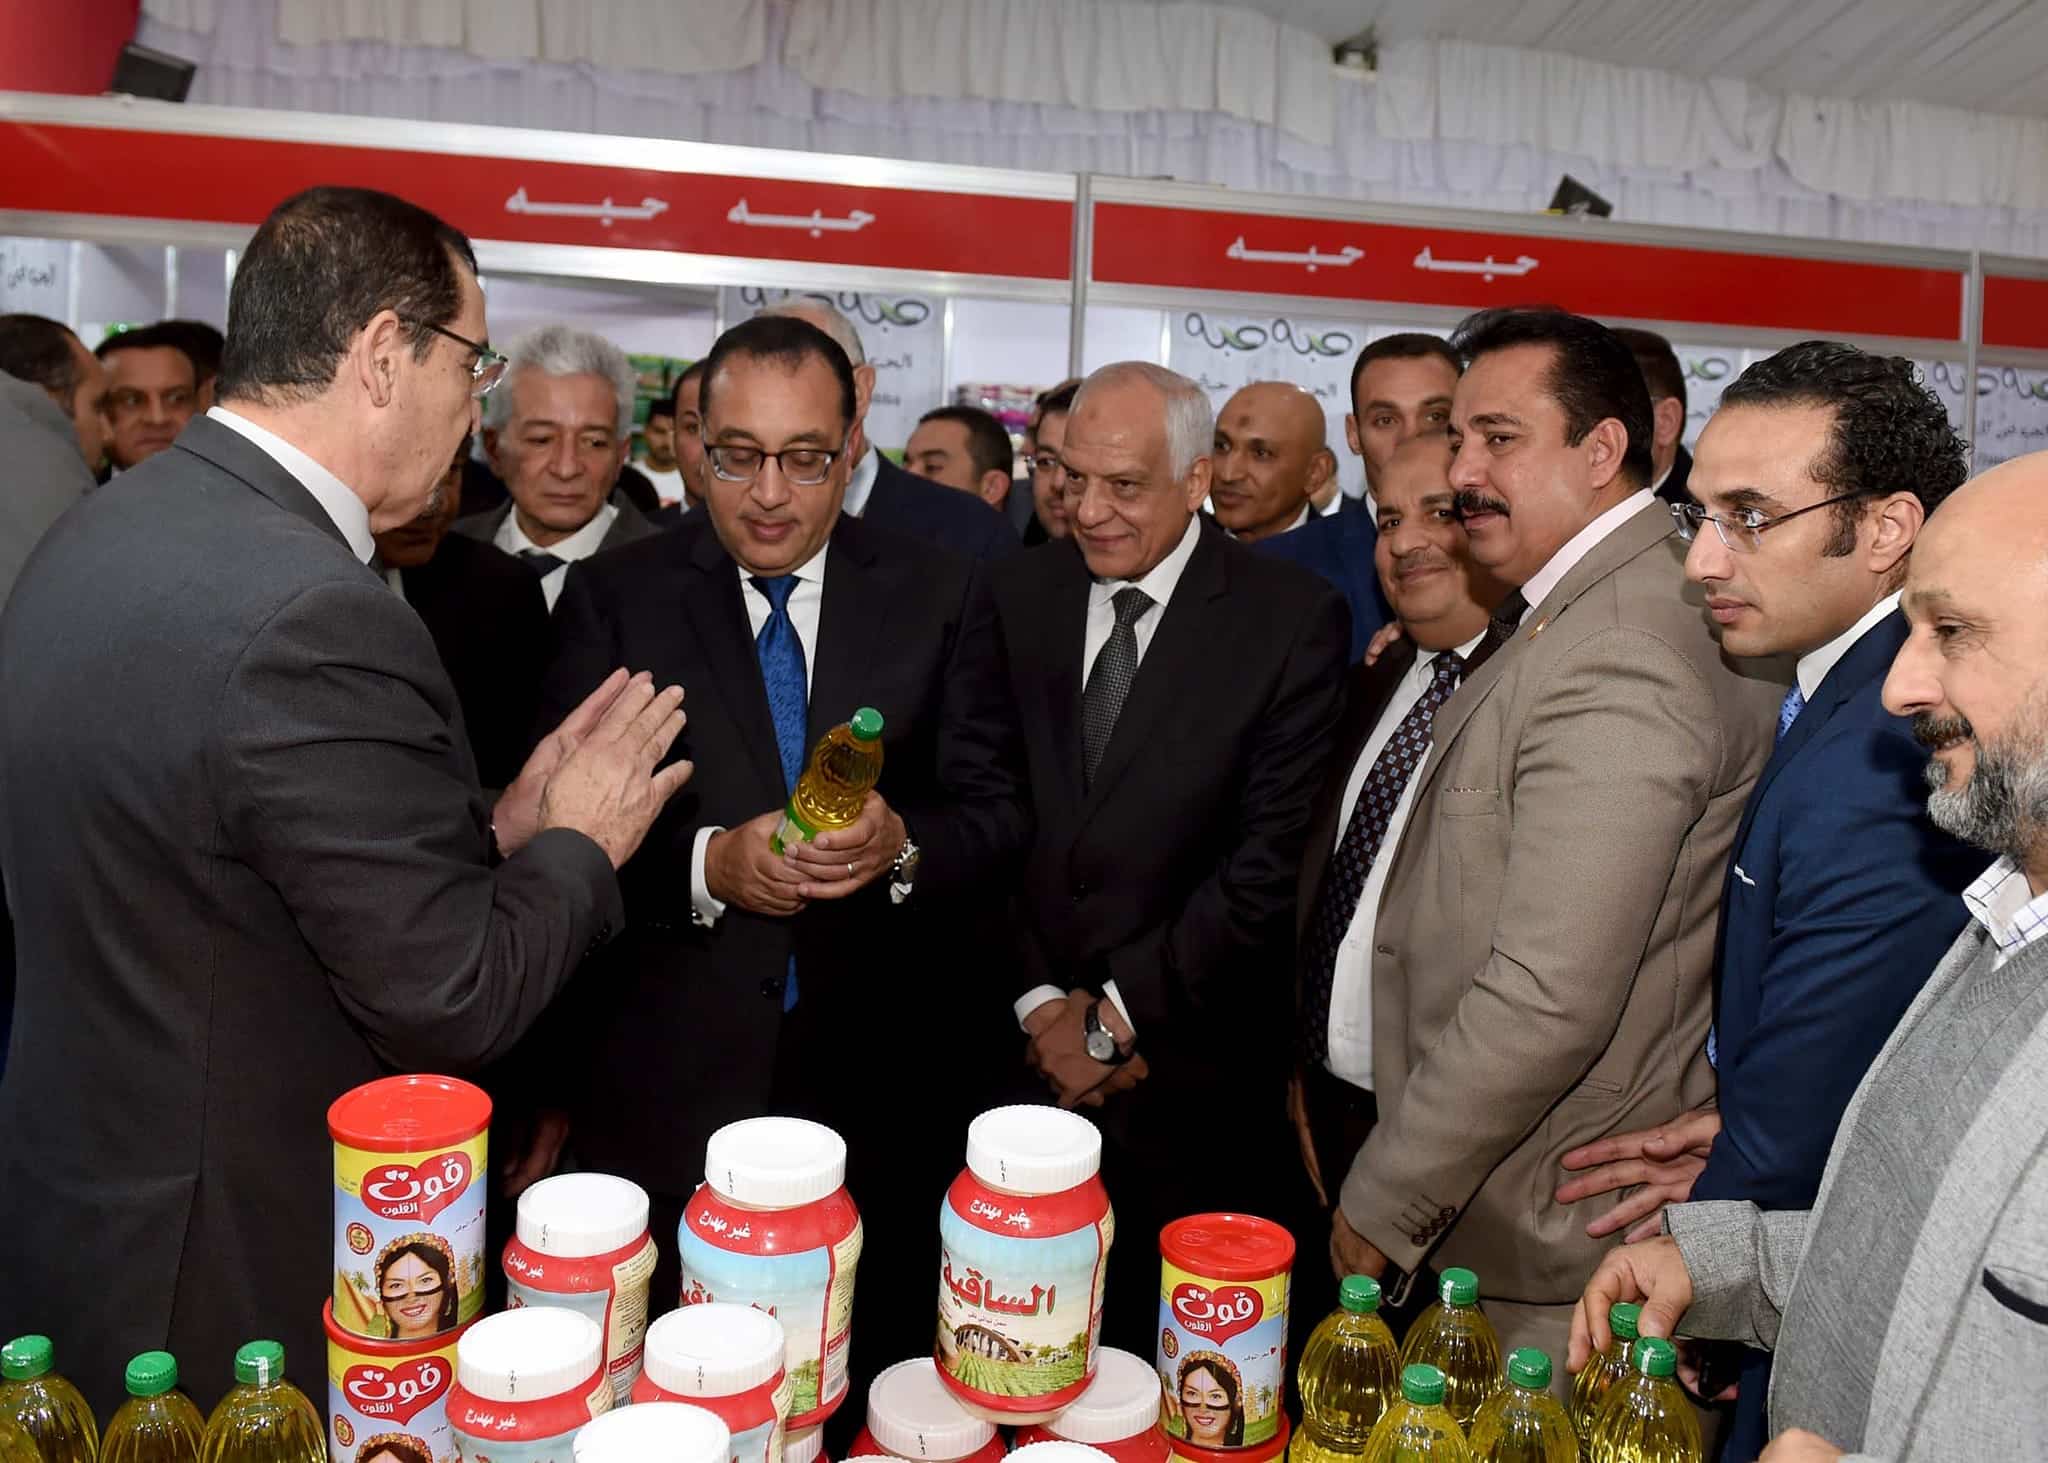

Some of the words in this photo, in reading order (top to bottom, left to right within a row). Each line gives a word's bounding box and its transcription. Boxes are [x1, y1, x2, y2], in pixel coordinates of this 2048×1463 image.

[505, 186, 669, 227] حبه
[727, 198, 876, 238] حبه
[1226, 236, 1365, 273] حبه
[1413, 246, 1539, 283] حبه
[368, 1158, 464, 1203] قوت
[381, 1202, 418, 1216] القلوب
[1003, 1208, 1031, 1229] غير
[727, 1221, 752, 1240] غير
[943, 1249, 1056, 1316] الساقية
[1176, 1289, 1254, 1326] قوت
[348, 1363, 441, 1405] قوت
[360, 1402, 394, 1415] القلوب
[496, 1413, 518, 1430] غير
